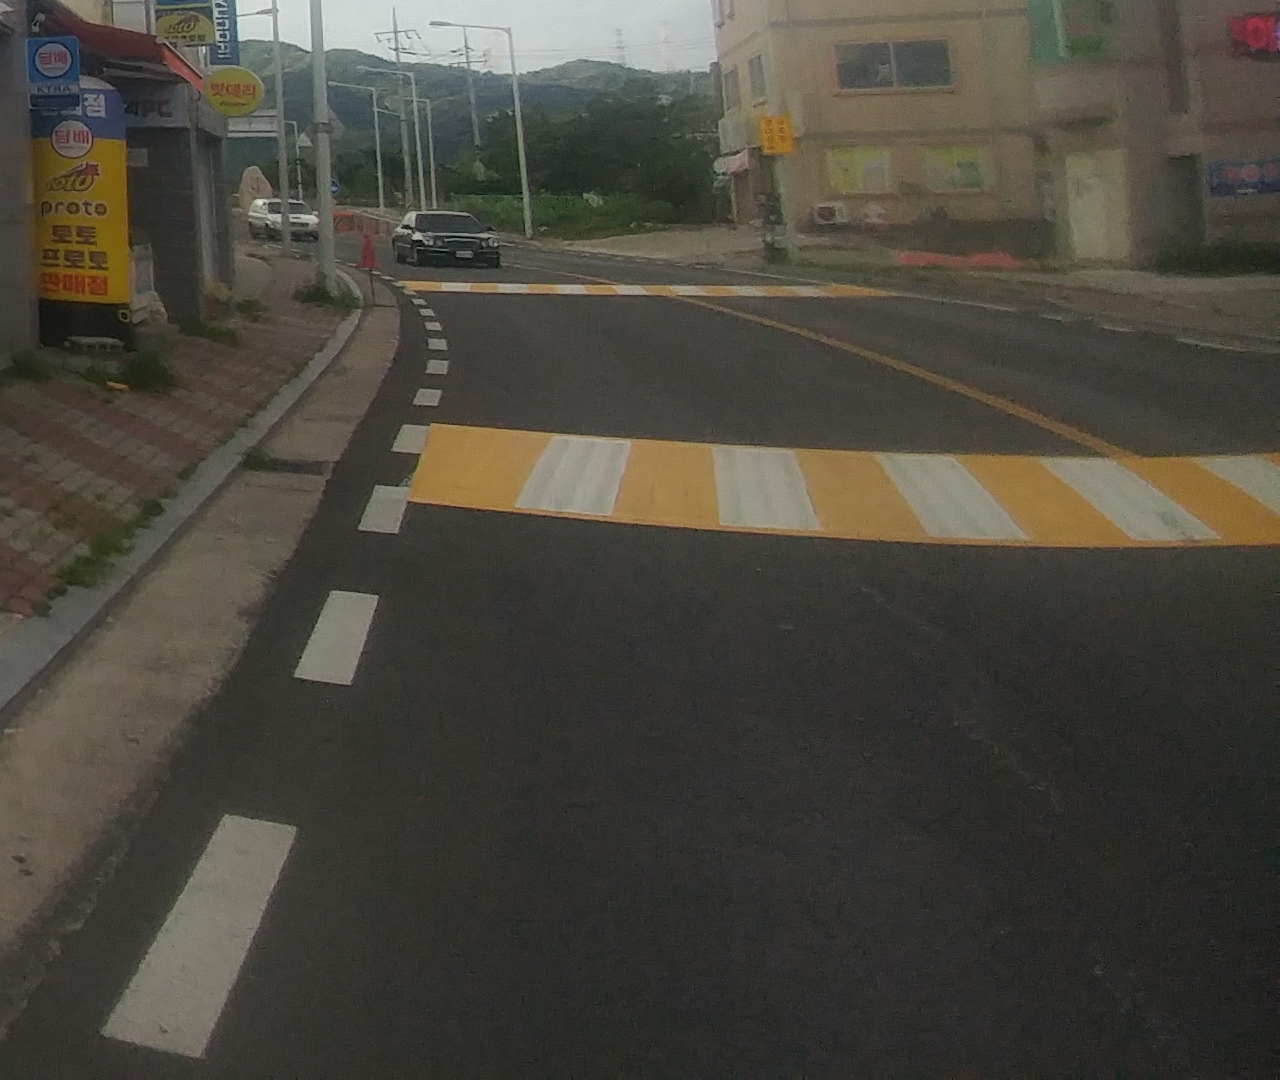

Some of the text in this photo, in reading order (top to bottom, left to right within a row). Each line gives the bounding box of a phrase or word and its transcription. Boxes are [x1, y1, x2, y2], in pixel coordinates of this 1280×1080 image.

[54, 128, 90, 145] 담배
[40, 199, 109, 218] proto
[50, 224, 98, 245] 토토
[40, 248, 110, 271] 프로토
